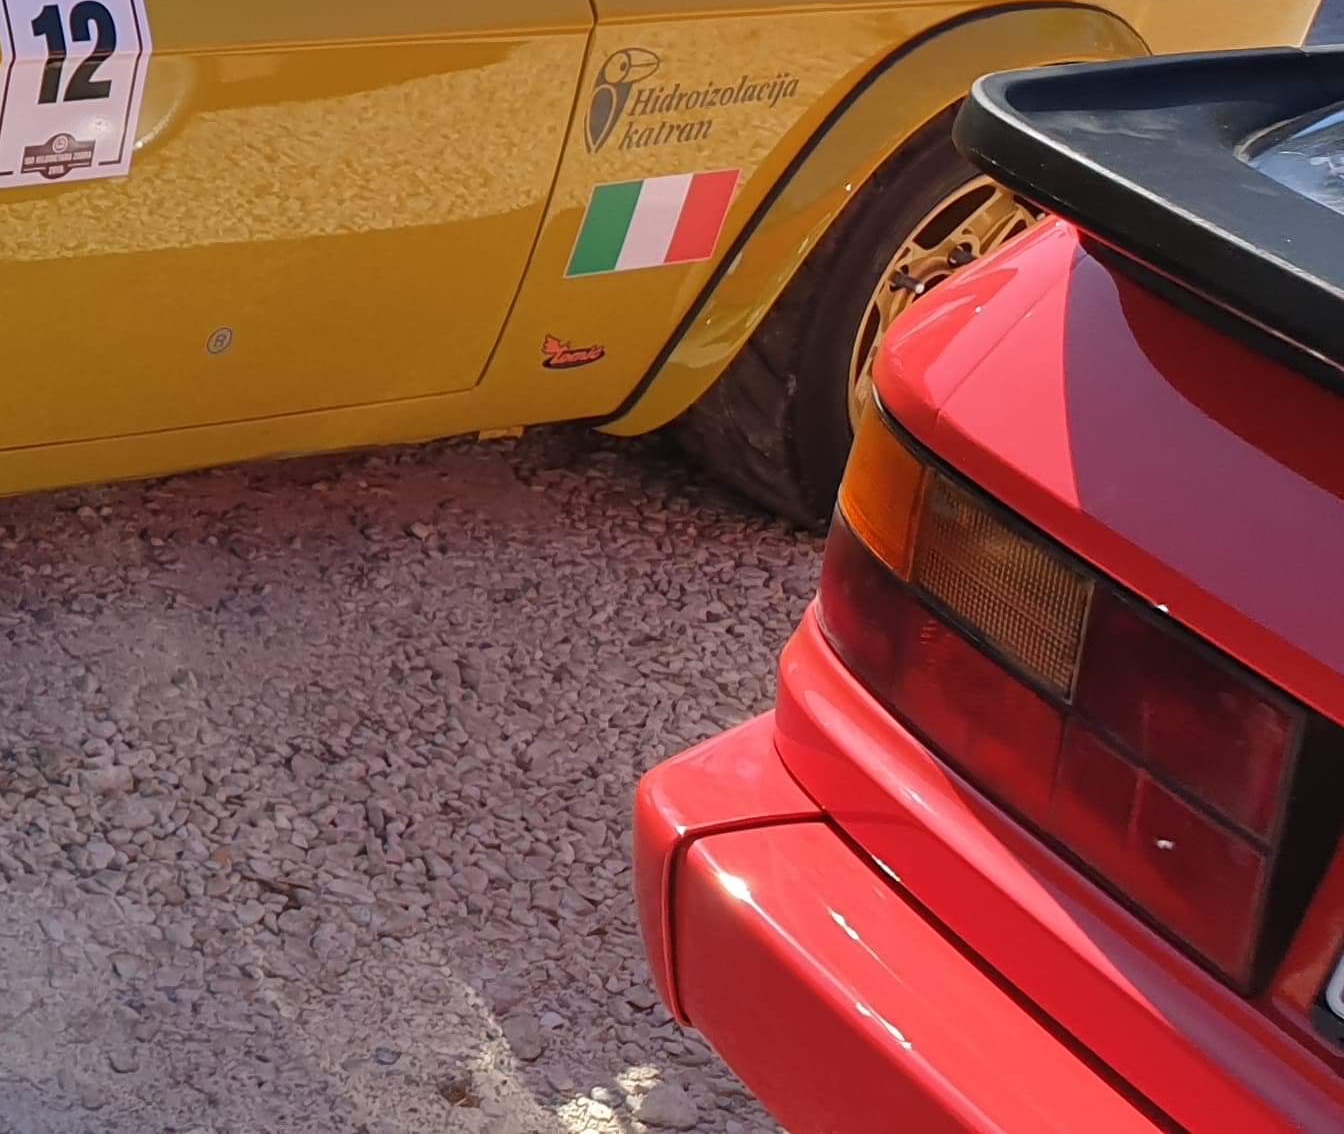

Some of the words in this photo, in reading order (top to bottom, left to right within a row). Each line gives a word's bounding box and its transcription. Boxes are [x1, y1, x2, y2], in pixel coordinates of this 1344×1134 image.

[31, 0, 117, 105] 12
[628, 73, 800, 116] Hidroizolacija
[617, 118, 713, 151] katran
